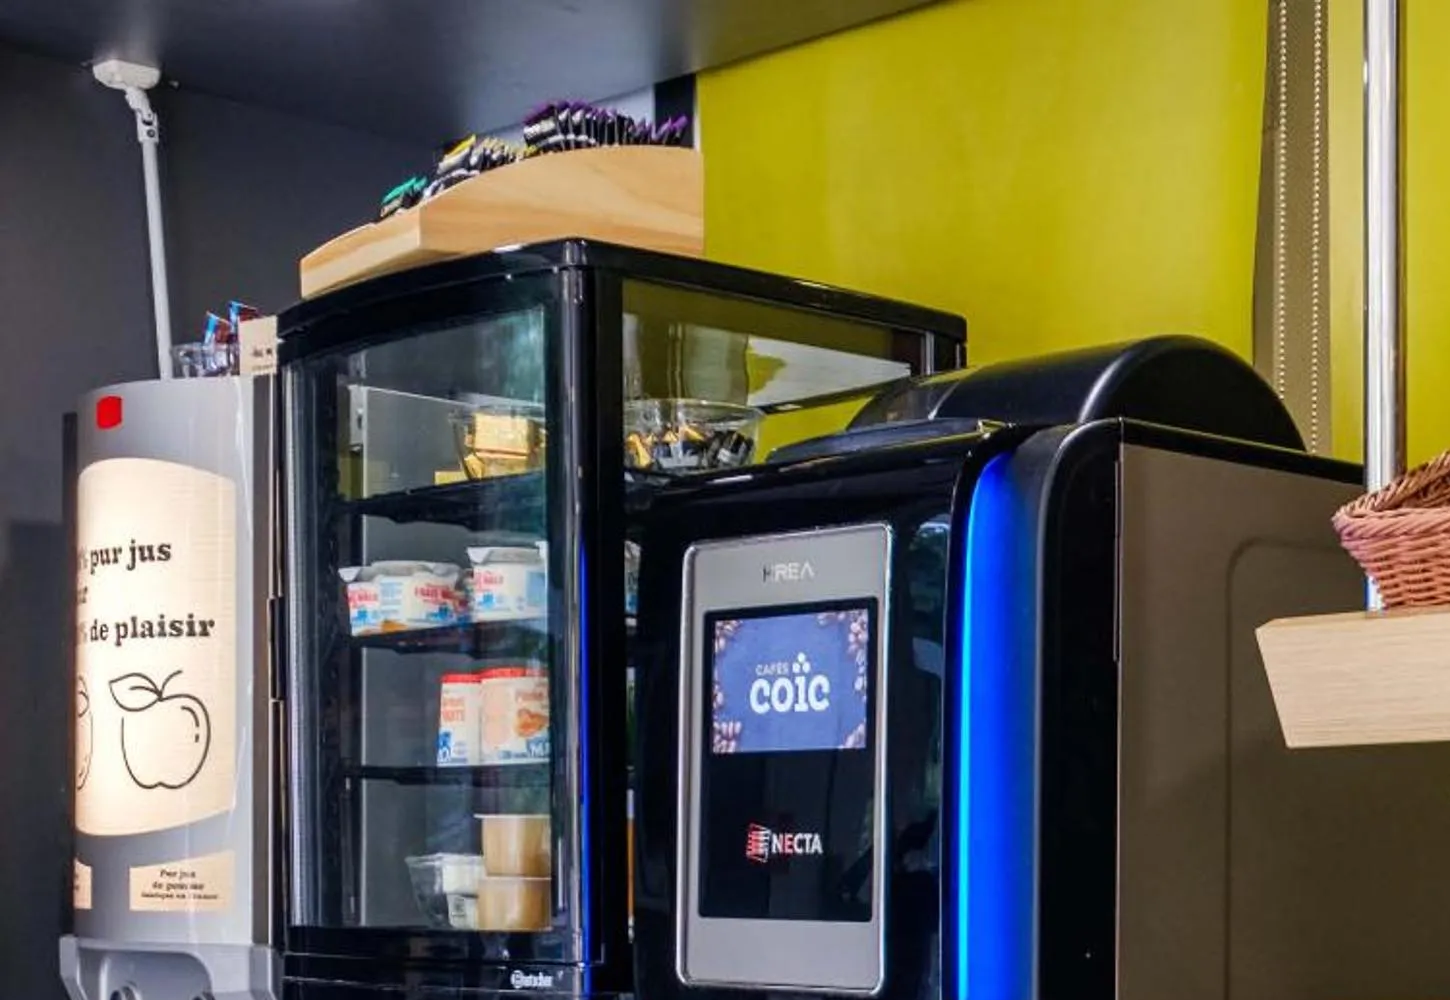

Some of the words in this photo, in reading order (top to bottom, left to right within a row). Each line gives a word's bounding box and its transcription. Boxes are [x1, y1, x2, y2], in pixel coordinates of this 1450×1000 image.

[90, 546, 122, 575] pur
[126, 539, 172, 571] jus
[90, 618, 109, 642] de
[115, 612, 215, 647] plaisir
[771, 832, 823, 854] NECTA
